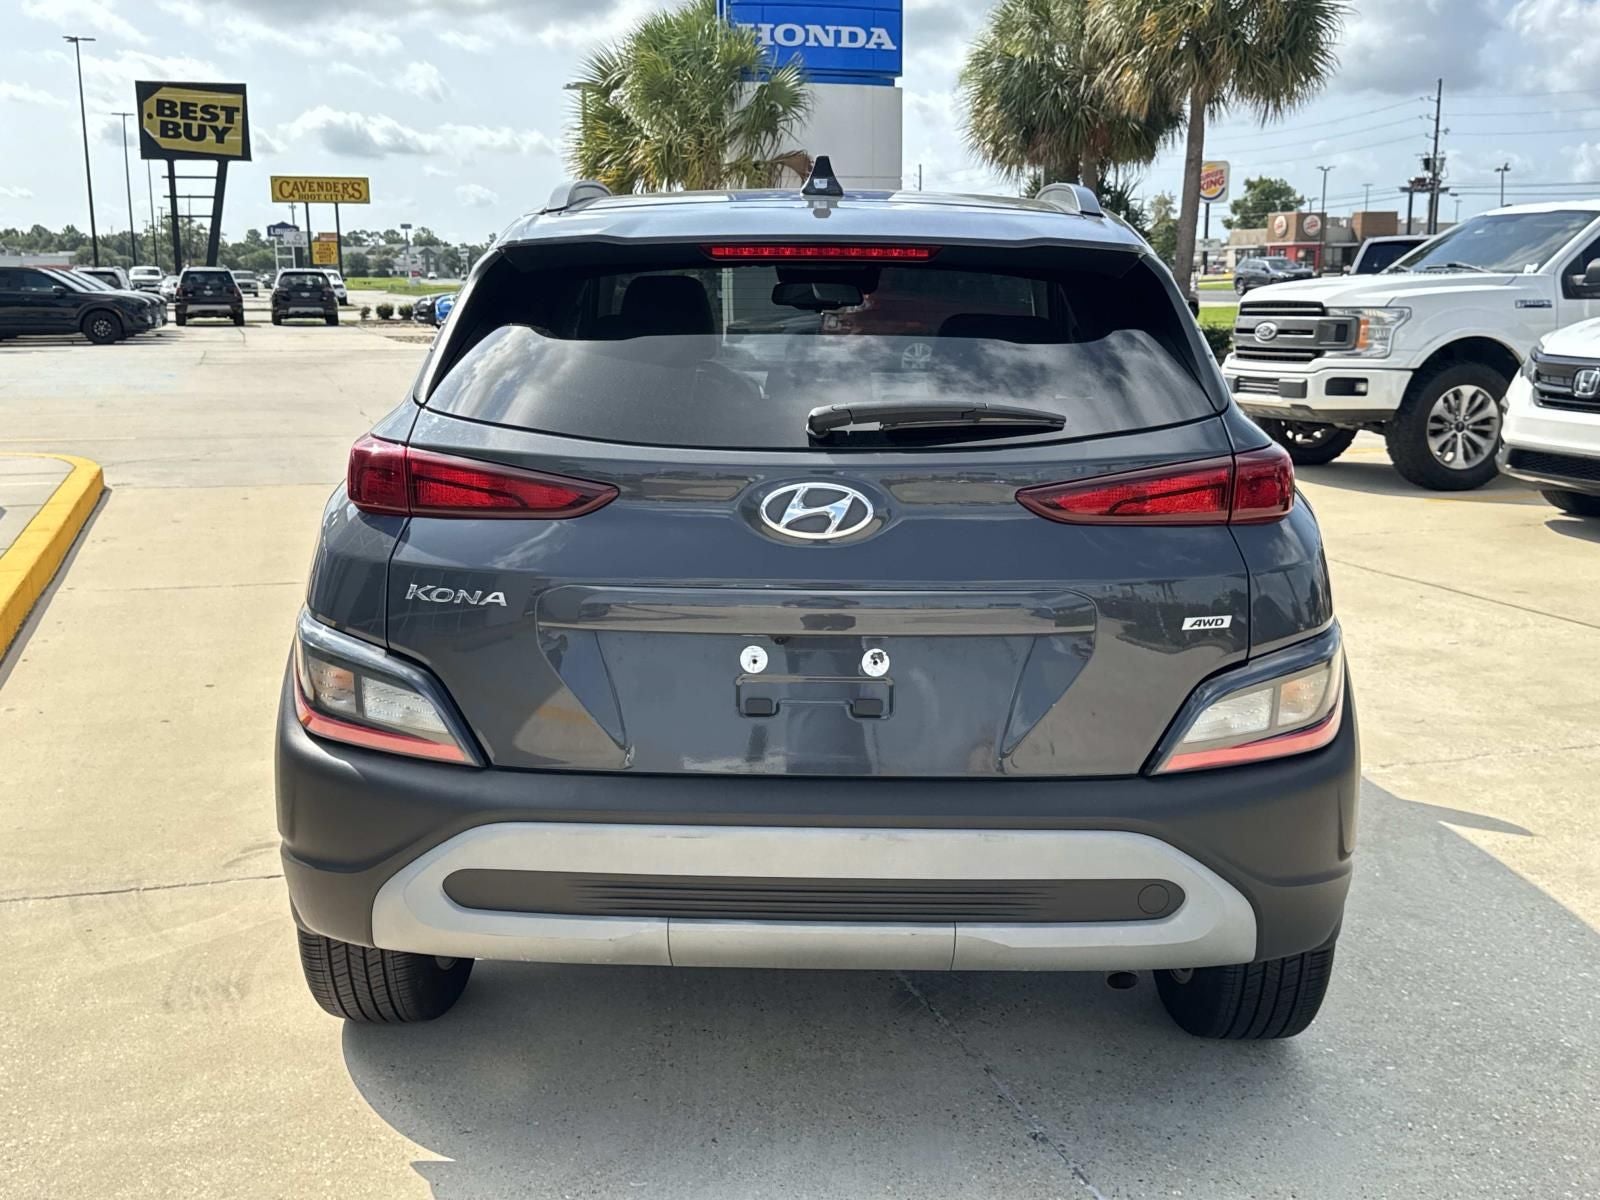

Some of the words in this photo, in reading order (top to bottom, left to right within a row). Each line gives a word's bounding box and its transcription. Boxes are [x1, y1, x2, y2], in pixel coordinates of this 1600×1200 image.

[736, 23, 897, 50] HONDA
[156, 98, 240, 124] BEST
[160, 119, 233, 144] BUY
[279, 179, 363, 200] CAVENDER'S
[405, 583, 507, 606] KONA
[1190, 618, 1224, 628] AWD
